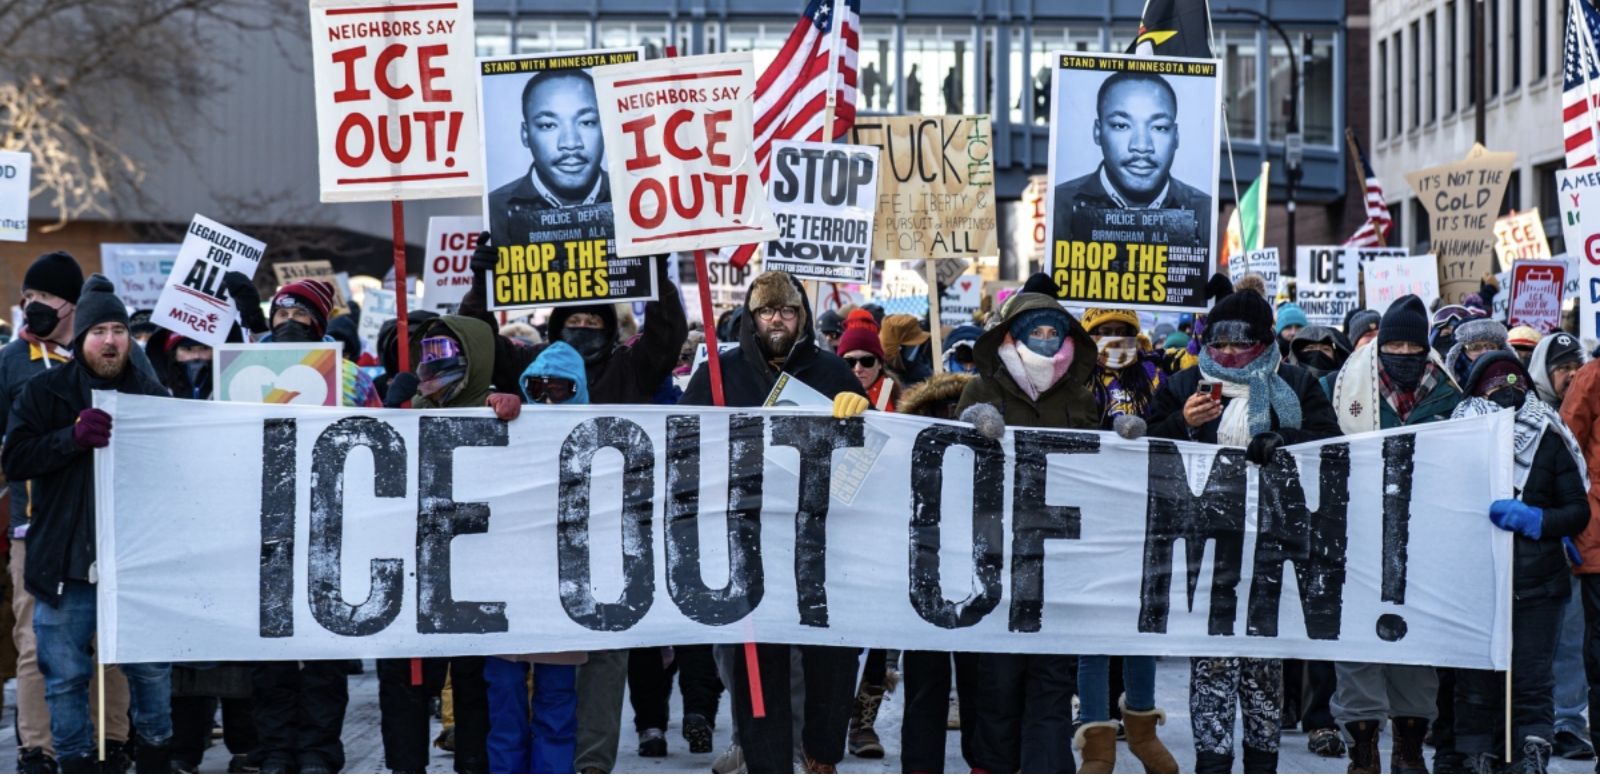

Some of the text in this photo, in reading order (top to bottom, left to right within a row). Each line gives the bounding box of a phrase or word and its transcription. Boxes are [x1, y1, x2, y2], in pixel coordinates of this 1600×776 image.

[328, 20, 456, 42] NEIGHBORS SAY
[332, 43, 453, 103] ICE
[484, 52, 636, 73] STAND WITH MINNESOTA NOW!
[1063, 57, 1214, 75] STAND WITH MINNESOTA NOW!
[617, 87, 740, 113] NEIGHBORS SAY
[335, 110, 464, 168] OUT!
[621, 109, 732, 171] ICE
[773, 147, 873, 206] STOP
[1419, 169, 1503, 192] IT'S NOT THE
[629, 172, 749, 229] OUT!
[976, 190, 988, 209] &
[541, 210, 600, 226] POLICE DEPT
[774, 212, 798, 239] CE
[801, 215, 868, 245] TERROR
[886, 217, 933, 230] PURSUIT
[946, 217, 995, 231] HAPPINESS
[1105, 213, 1164, 226] POLICE DEPT
[1436, 216, 1459, 231] IT'S
[1463, 213, 1487, 230] THE
[189, 221, 262, 262] LEGALIZATION
[440, 233, 480, 251] ICE
[529, 226, 607, 243] BIRMINGHAM ALA
[886, 231, 978, 253] FOR ALL
[1091, 229, 1169, 242] BIRMINGHAM ALA
[1499, 223, 1536, 246] ICE
[206, 245, 233, 267] FOR
[495, 243, 556, 275] DROP
[564, 239, 607, 270] THE
[767, 240, 867, 264] NOW!
[1055, 240, 1117, 271] DROP
[1126, 243, 1168, 273] THE
[1168, 253, 1205, 262] ARMSTRONG
[1193, 247, 1208, 255] LEVY
[1251, 252, 1276, 260] OUT
[432, 255, 474, 274] OU
[708, 261, 752, 286] STOP
[767, 262, 785, 271] PARTY
[785, 263, 795, 272] FOR
[796, 264, 825, 275] SOCIALISM
[825, 267, 832, 275] &
[1309, 249, 1346, 283] ICE
[1443, 261, 1475, 279] ITY!
[182, 258, 229, 303] ALL
[437, 277, 447, 286] of
[496, 269, 609, 303] CHARGES
[609, 280, 636, 288] WILLIAM
[1055, 269, 1167, 302] CHARGES
[1167, 274, 1186, 282] ALLEN
[609, 287, 628, 295] KELLY
[1166, 295, 1184, 303] KELLY
[1167, 287, 1193, 296] WILLIAM
[1299, 301, 1356, 315] MINNESOTA
[845, 446, 865, 464] TH
[839, 448, 878, 502] CHARGES
[259, 413, 1417, 642] ICE OUT OF MN!
